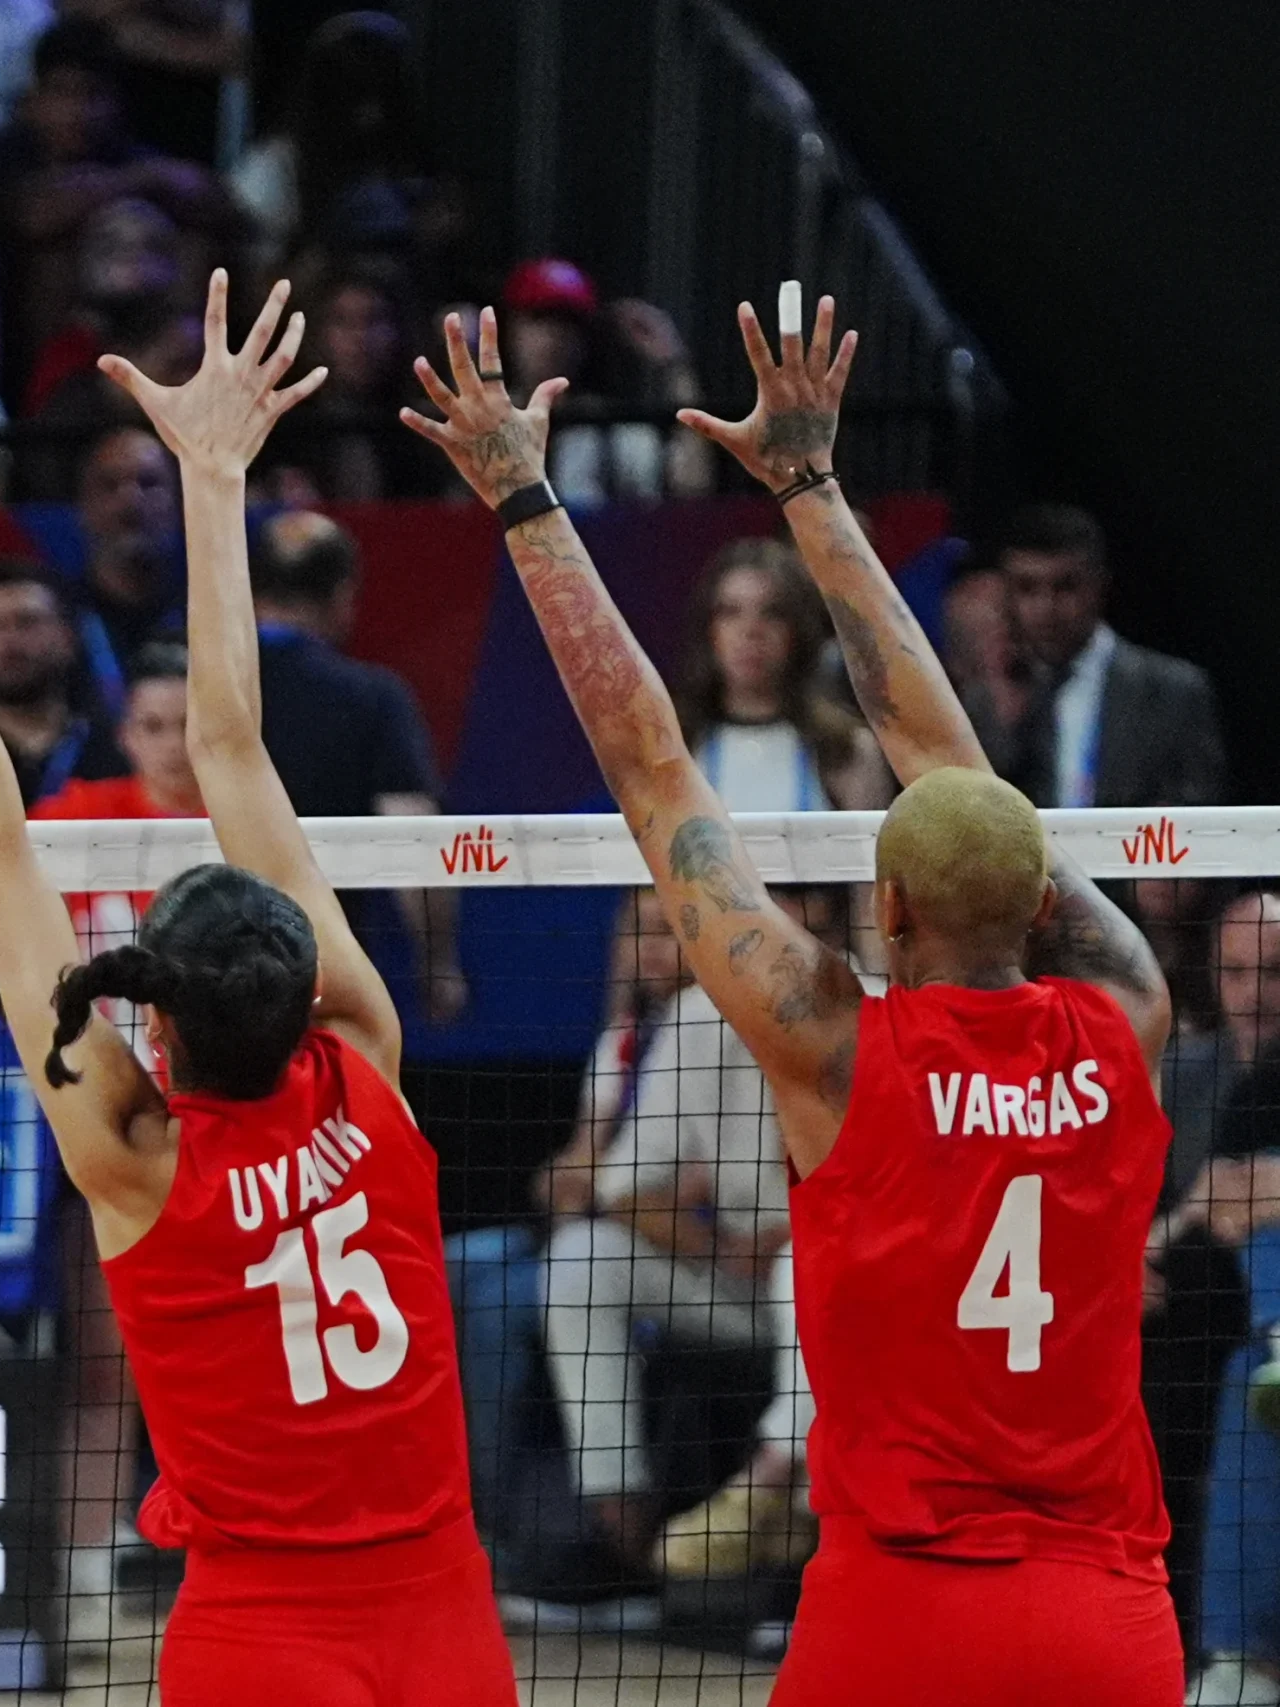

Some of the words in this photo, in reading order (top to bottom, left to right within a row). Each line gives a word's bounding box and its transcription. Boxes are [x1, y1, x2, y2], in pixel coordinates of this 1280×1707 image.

[440, 819, 508, 875] VNL
[1122, 816, 1188, 864] VNL
[928, 1059, 1109, 1137] VARGAS
[244, 1191, 409, 1405] 15
[957, 1174, 1053, 1372] 4
